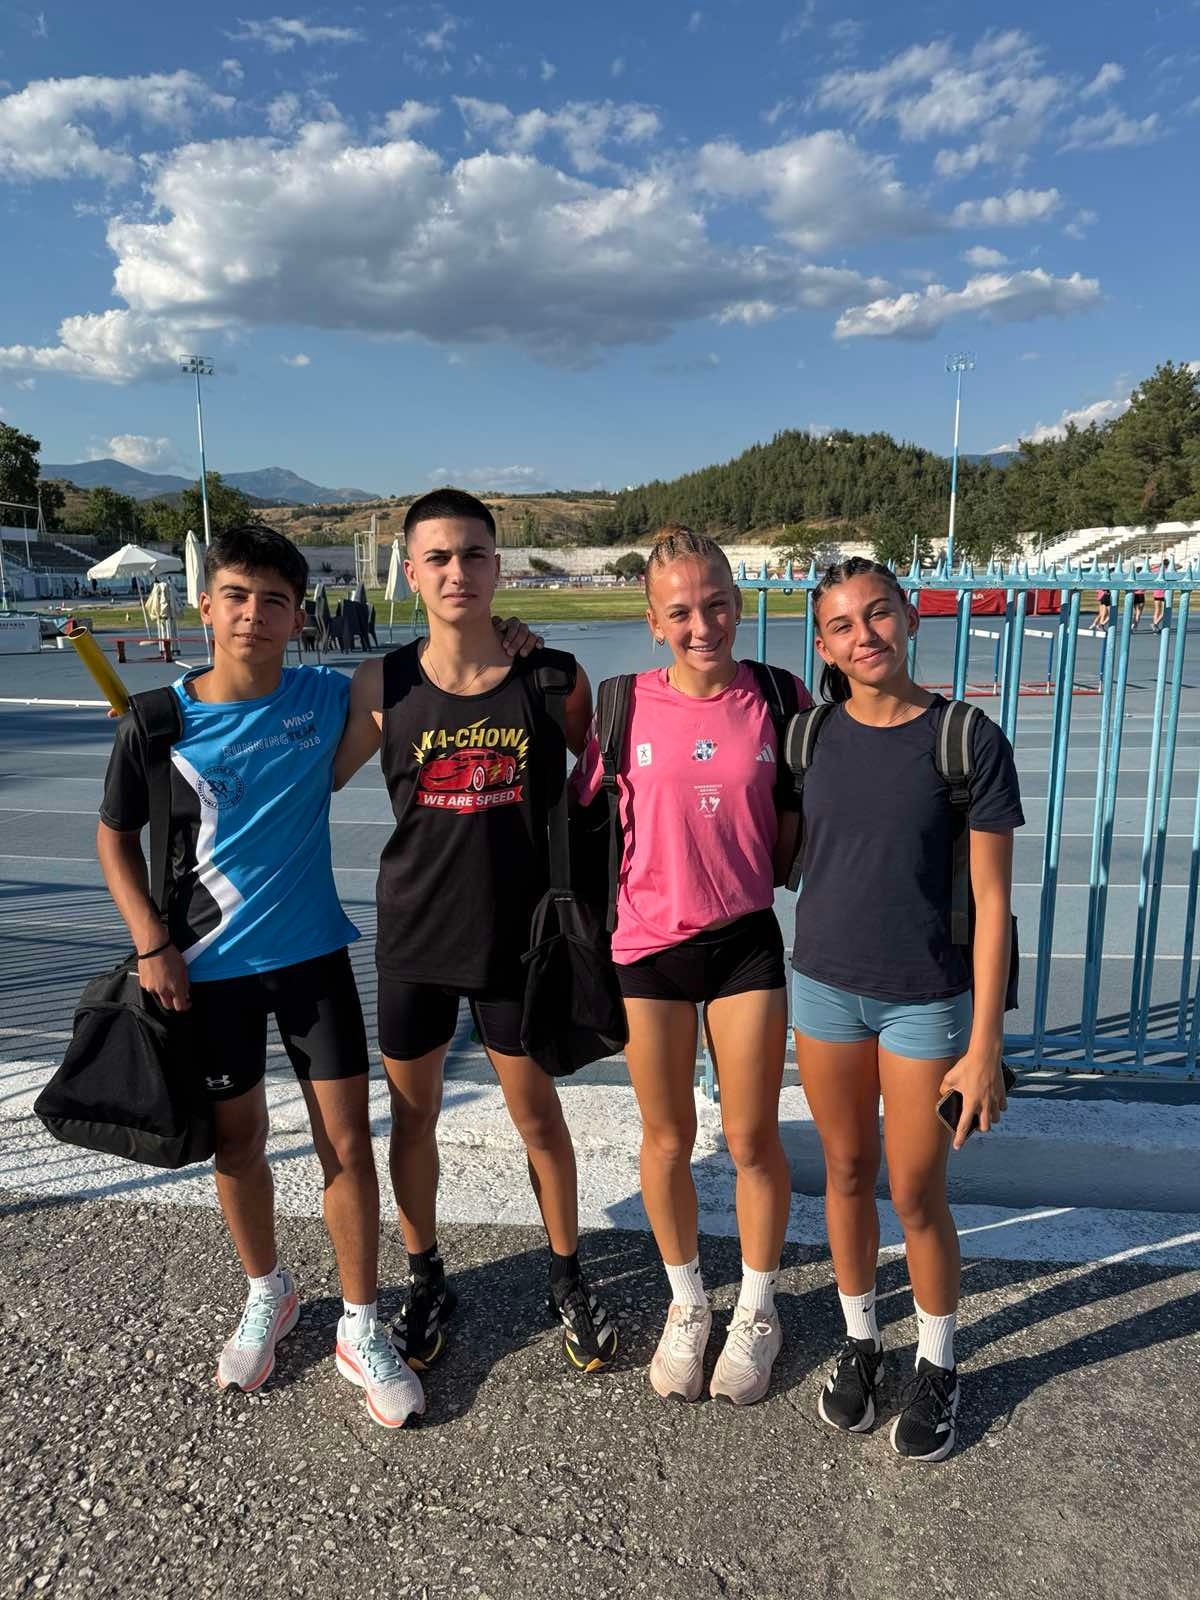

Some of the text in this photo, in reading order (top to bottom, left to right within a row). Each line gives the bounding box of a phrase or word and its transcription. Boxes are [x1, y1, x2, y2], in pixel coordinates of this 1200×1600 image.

[282, 710, 314, 729] WIND
[222, 733, 289, 758] RUNNING
[299, 736, 321, 751] 2018
[421, 728, 524, 751] KA-CHOW
[424, 790, 515, 806] WE ARE SPEED
